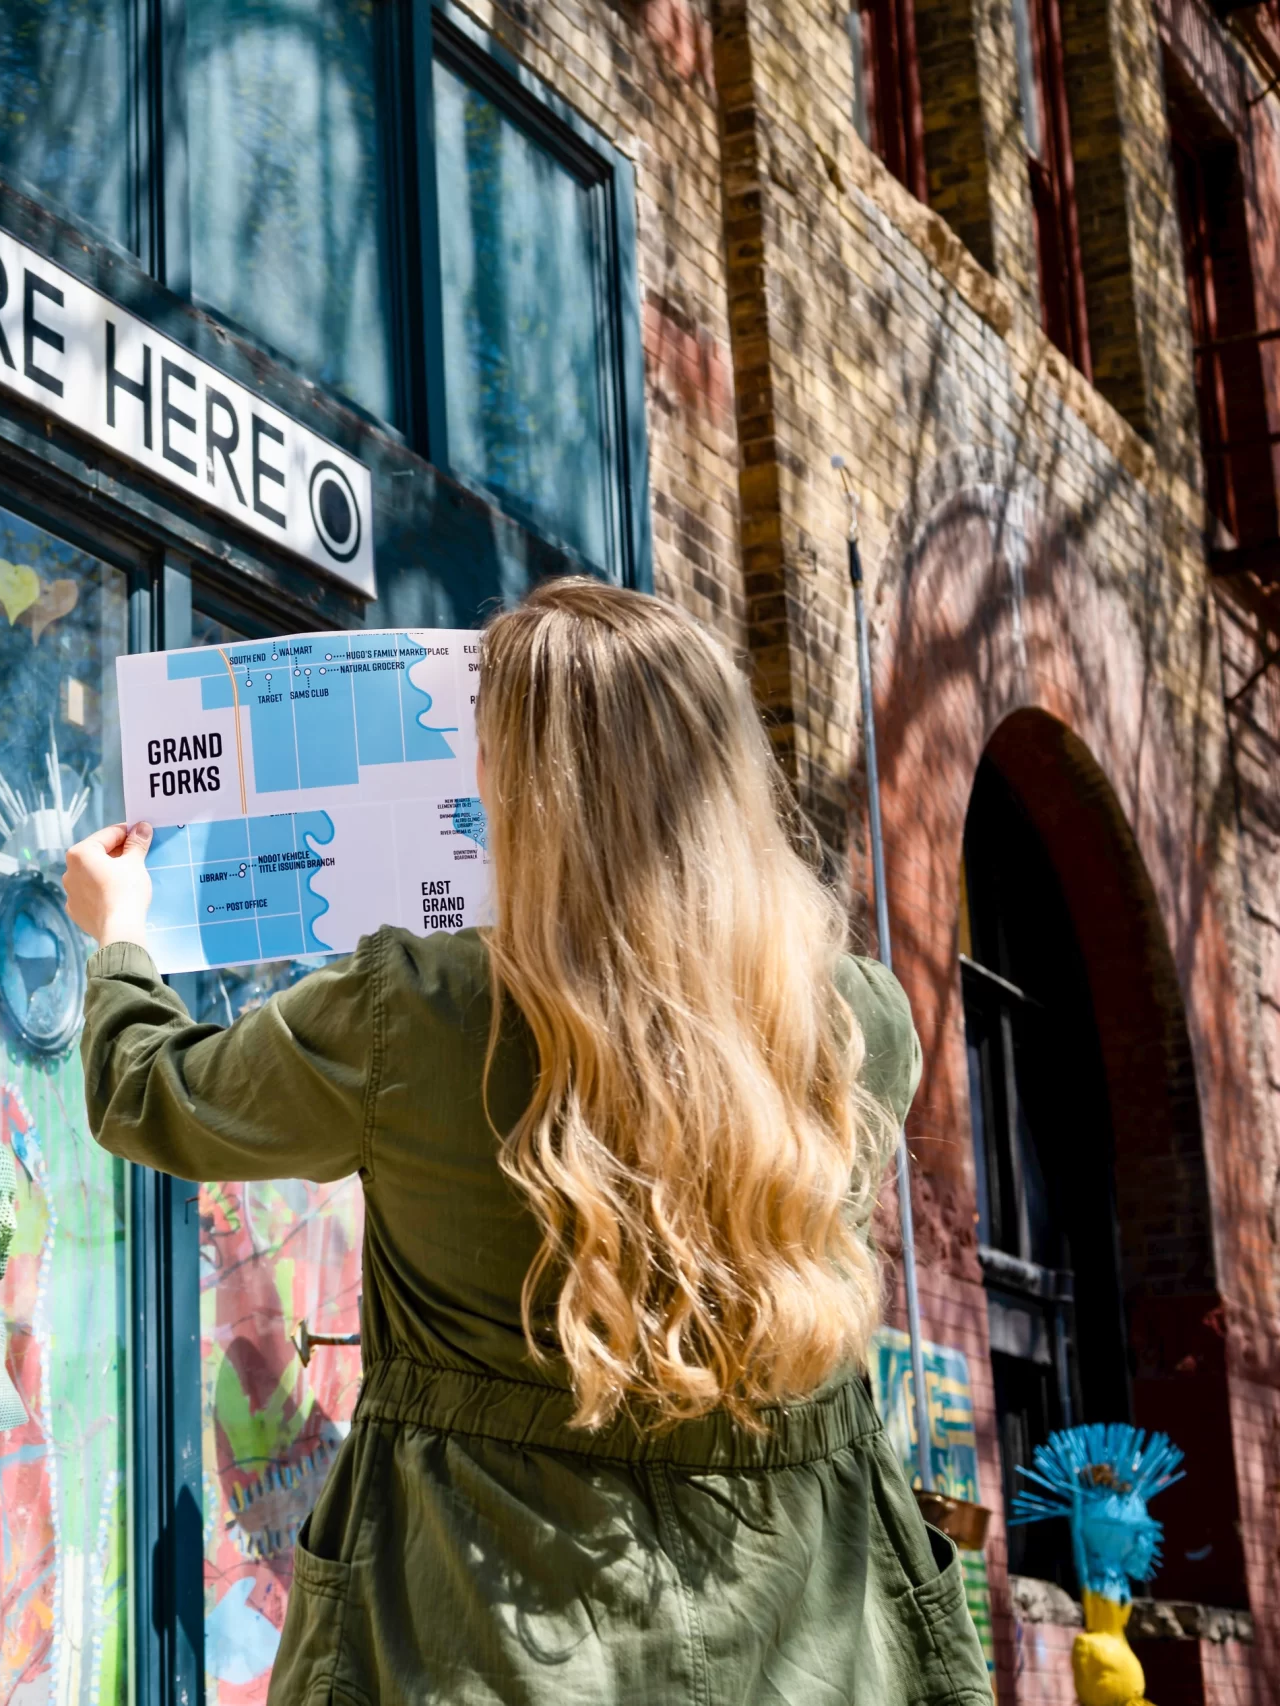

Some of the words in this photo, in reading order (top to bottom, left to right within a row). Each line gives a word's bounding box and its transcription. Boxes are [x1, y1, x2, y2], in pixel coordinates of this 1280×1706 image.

[105, 319, 288, 530] HERE
[279, 645, 313, 657] WALMART
[346, 649, 373, 660] HUGO'S
[373, 648, 398, 659] FAMILY
[399, 647, 449, 657] MARKETPLACE
[229, 654, 252, 665] SOUTH
[252, 652, 266, 663] END
[340, 663, 371, 674] NATURAL
[372, 661, 405, 672] GROCERS
[257, 693, 283, 704] TARGET
[289, 690, 310, 700] SAMS
[311, 688, 329, 698] CLUB
[147, 732, 223, 765] GRAND
[149, 765, 221, 798] FORKS
[281, 850, 310, 862] VEHICLE
[258, 862, 277, 874] TITLE
[277, 859, 306, 872] ISSUING
[306, 857, 336, 869] BRANCH
[199, 871, 228, 883] LIBRARY
[421, 880, 451, 896] EAST
[226, 901, 244, 912] POST
[244, 898, 268, 910] OFFICE
[422, 896, 465, 913] GRAND
[423, 913, 464, 930] FORKS
